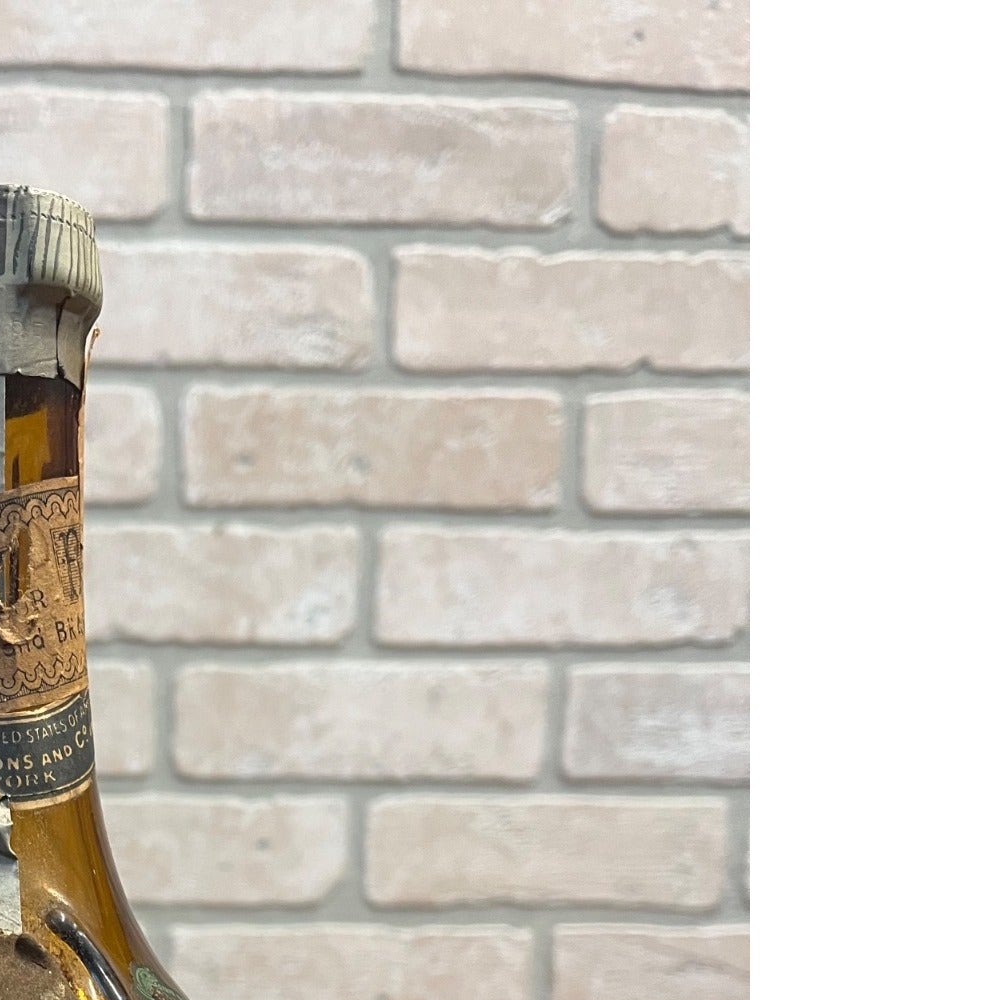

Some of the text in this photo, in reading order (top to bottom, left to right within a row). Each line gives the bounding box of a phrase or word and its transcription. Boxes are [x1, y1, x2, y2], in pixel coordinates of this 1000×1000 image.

[26, 721, 68, 744] STATES
[68, 708, 79, 728] OF
[41, 744, 73, 767] AND
